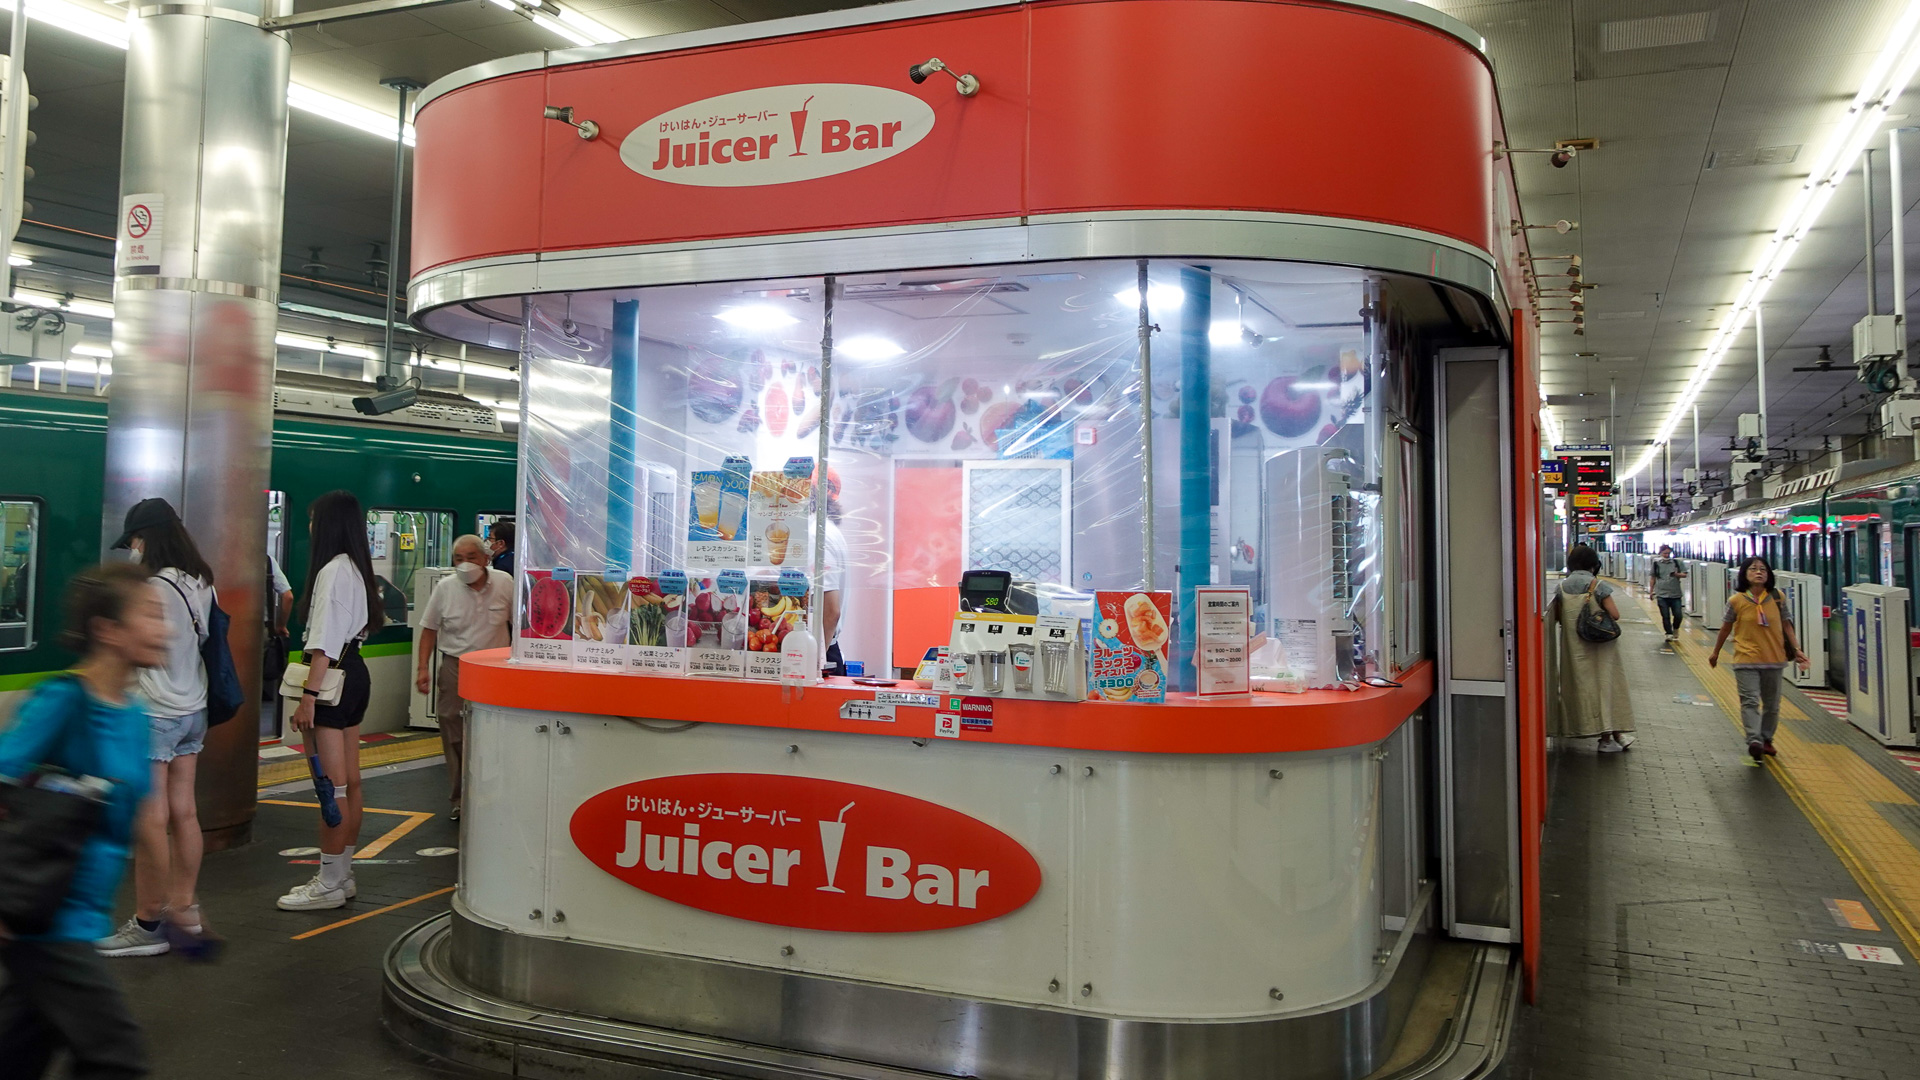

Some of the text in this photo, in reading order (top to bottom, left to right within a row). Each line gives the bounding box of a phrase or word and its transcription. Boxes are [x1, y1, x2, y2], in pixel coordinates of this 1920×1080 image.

[658, 110, 779, 133] けいはん・ジューサーバー
[652, 119, 902, 170] Juicer Bar
[130, 244, 145, 254] 禁煙
[985, 597, 999, 606] 580
[1094, 647, 1135, 659] フルーツ
[1094, 658, 1135, 669] ミックス
[1094, 668, 1135, 678] アイスバー
[1099, 677, 1135, 689] ¥300
[962, 703, 992, 713] WARNING
[626, 795, 802, 827] けいはん・ジューサーバー
[615, 819, 990, 909] Juicer Bar
